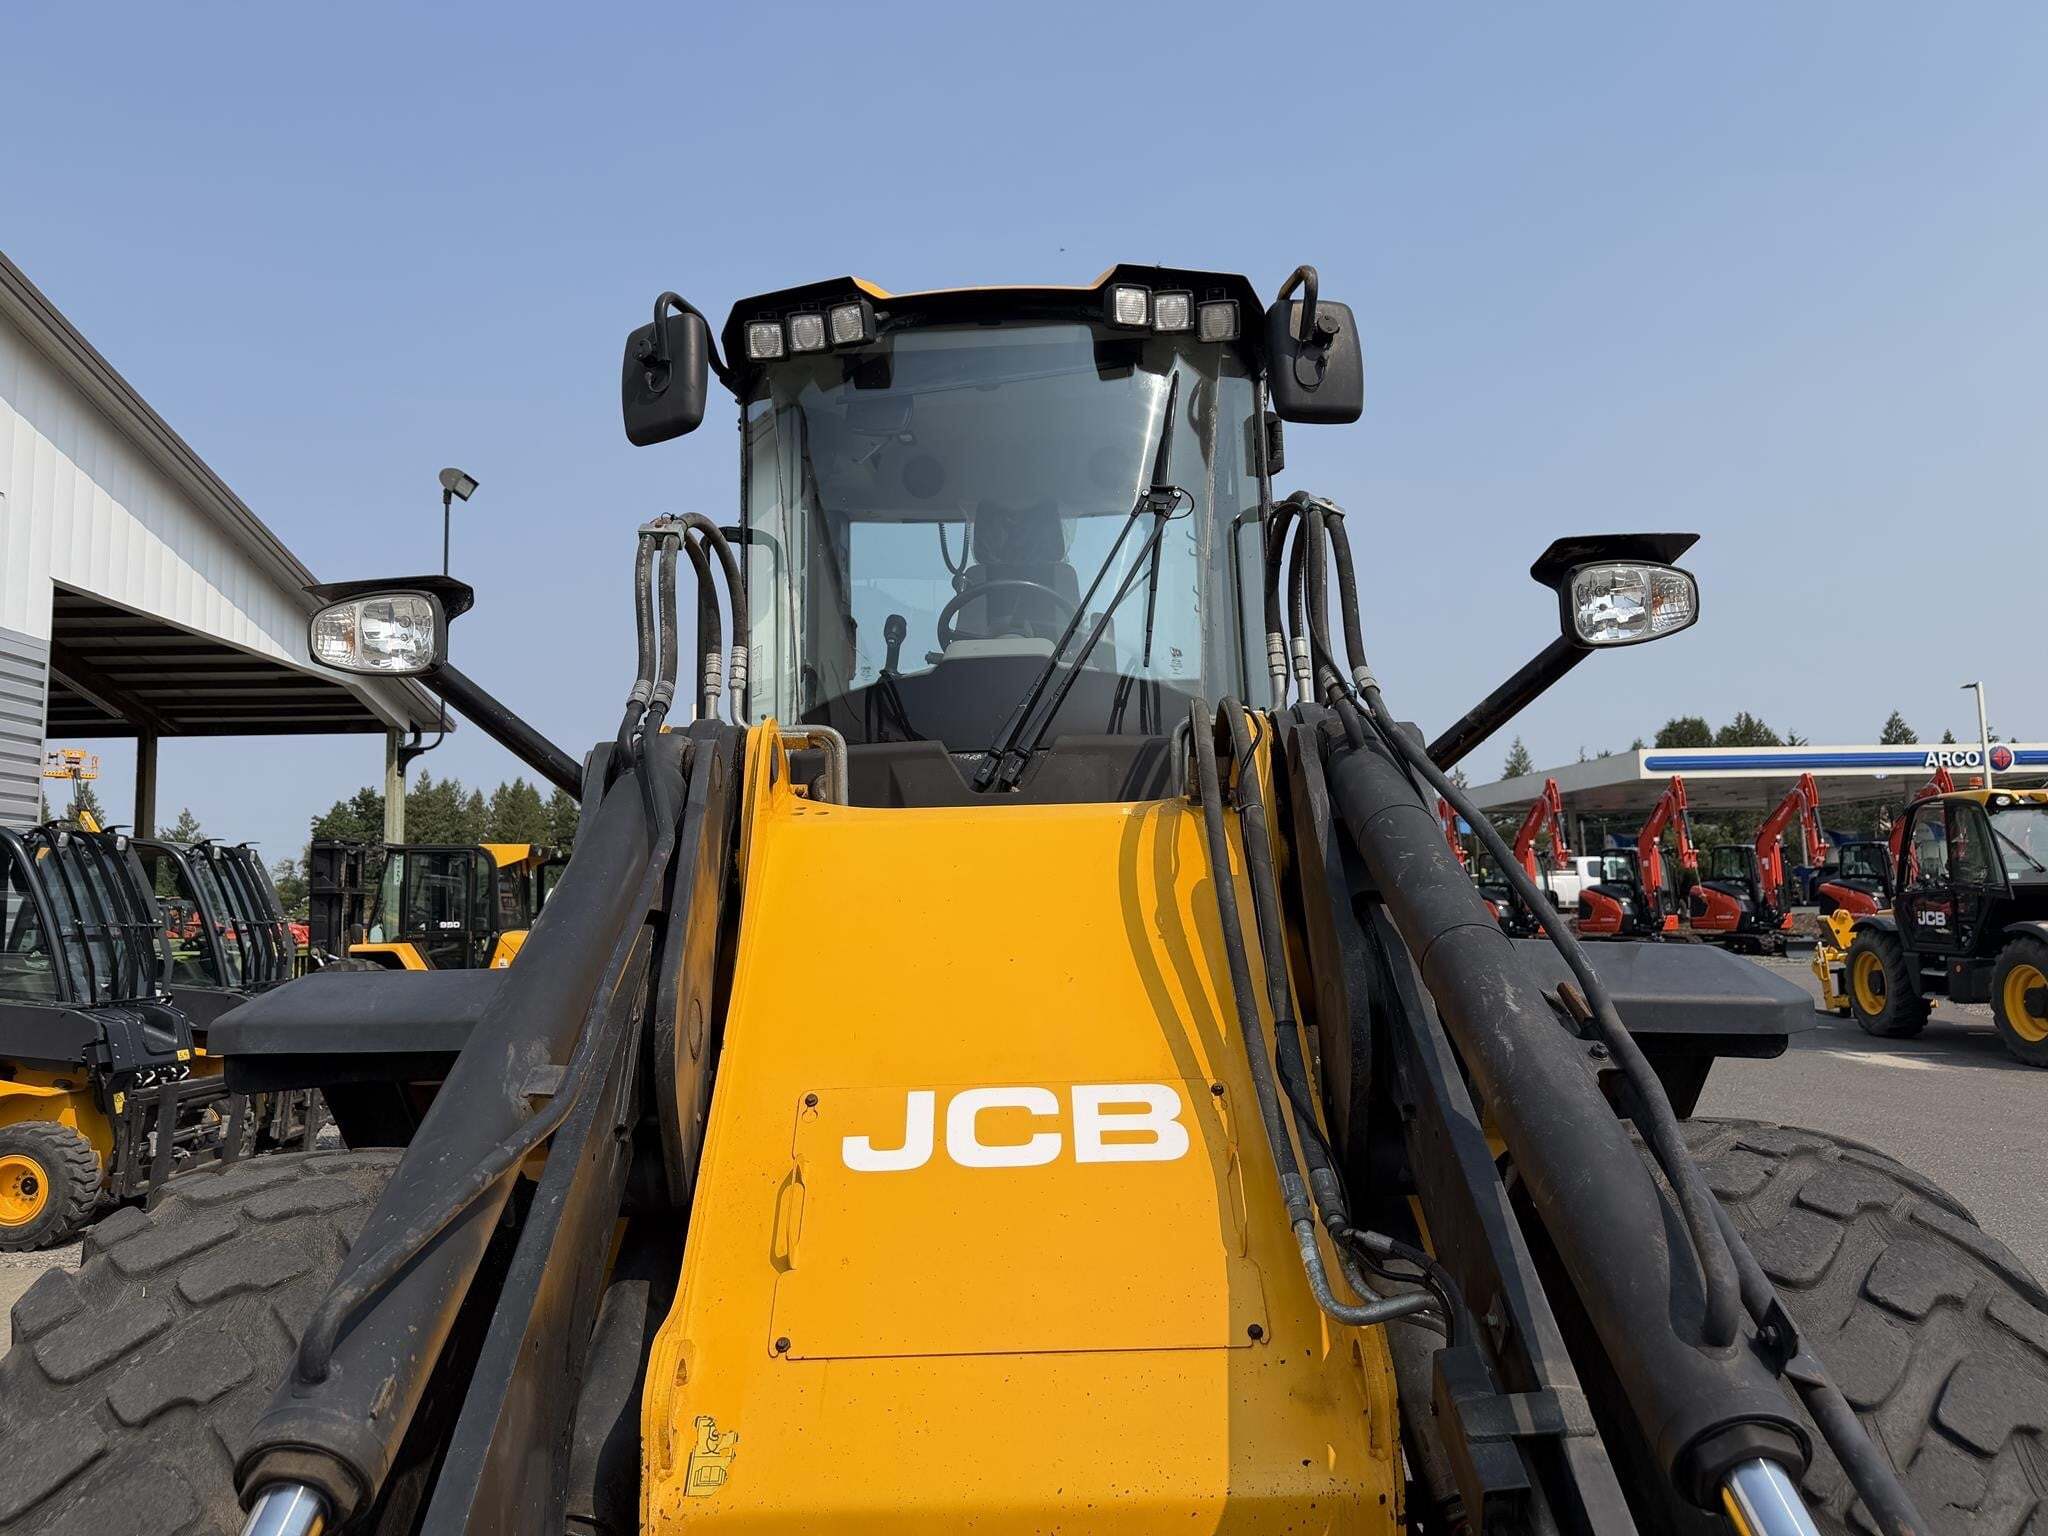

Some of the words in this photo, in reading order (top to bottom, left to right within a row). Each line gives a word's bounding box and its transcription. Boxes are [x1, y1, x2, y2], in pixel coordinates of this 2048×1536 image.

[1925, 751, 1980, 767] ARCO
[1917, 910, 1946, 926] JCB
[842, 1084, 1190, 1172] JCB
